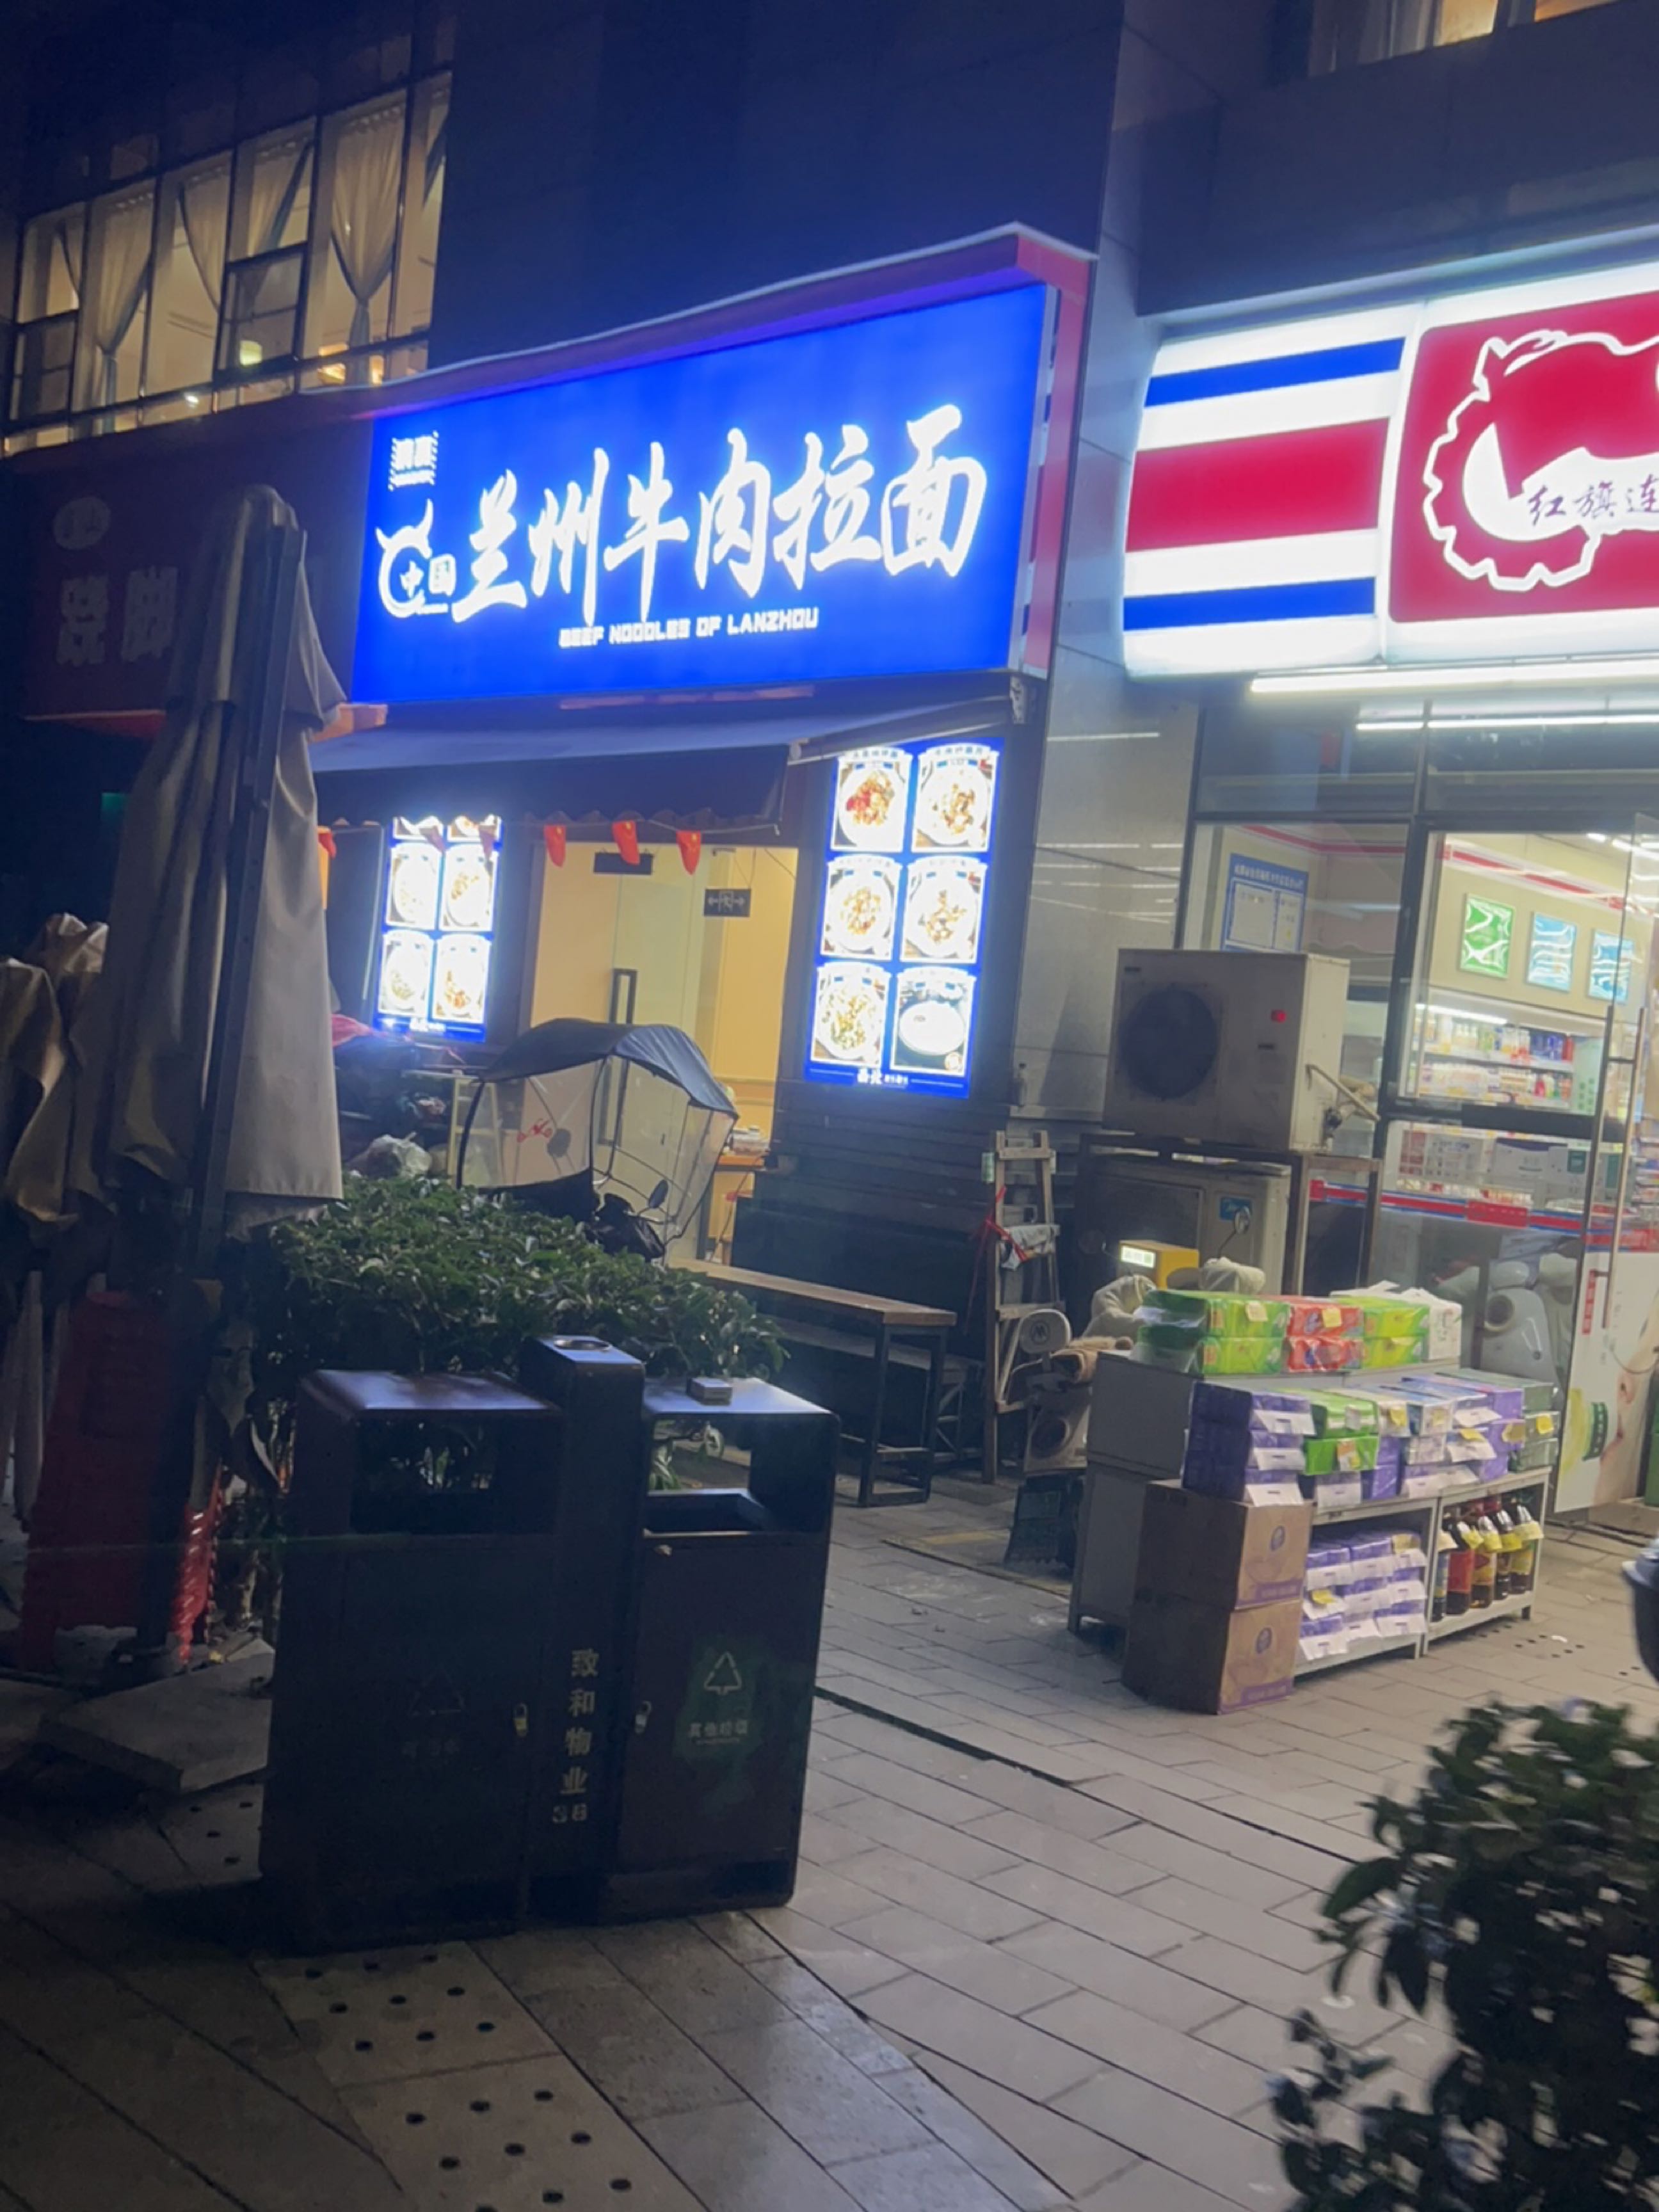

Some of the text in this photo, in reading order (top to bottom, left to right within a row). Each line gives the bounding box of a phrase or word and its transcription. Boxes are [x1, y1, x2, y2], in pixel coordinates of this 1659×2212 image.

[451, 404, 987, 626] 兰州牛肉拉面
[559, 606, 820, 648] BEEF NOODLES OF LANZHOU
[561, 1648, 599, 1794] 致和物业
